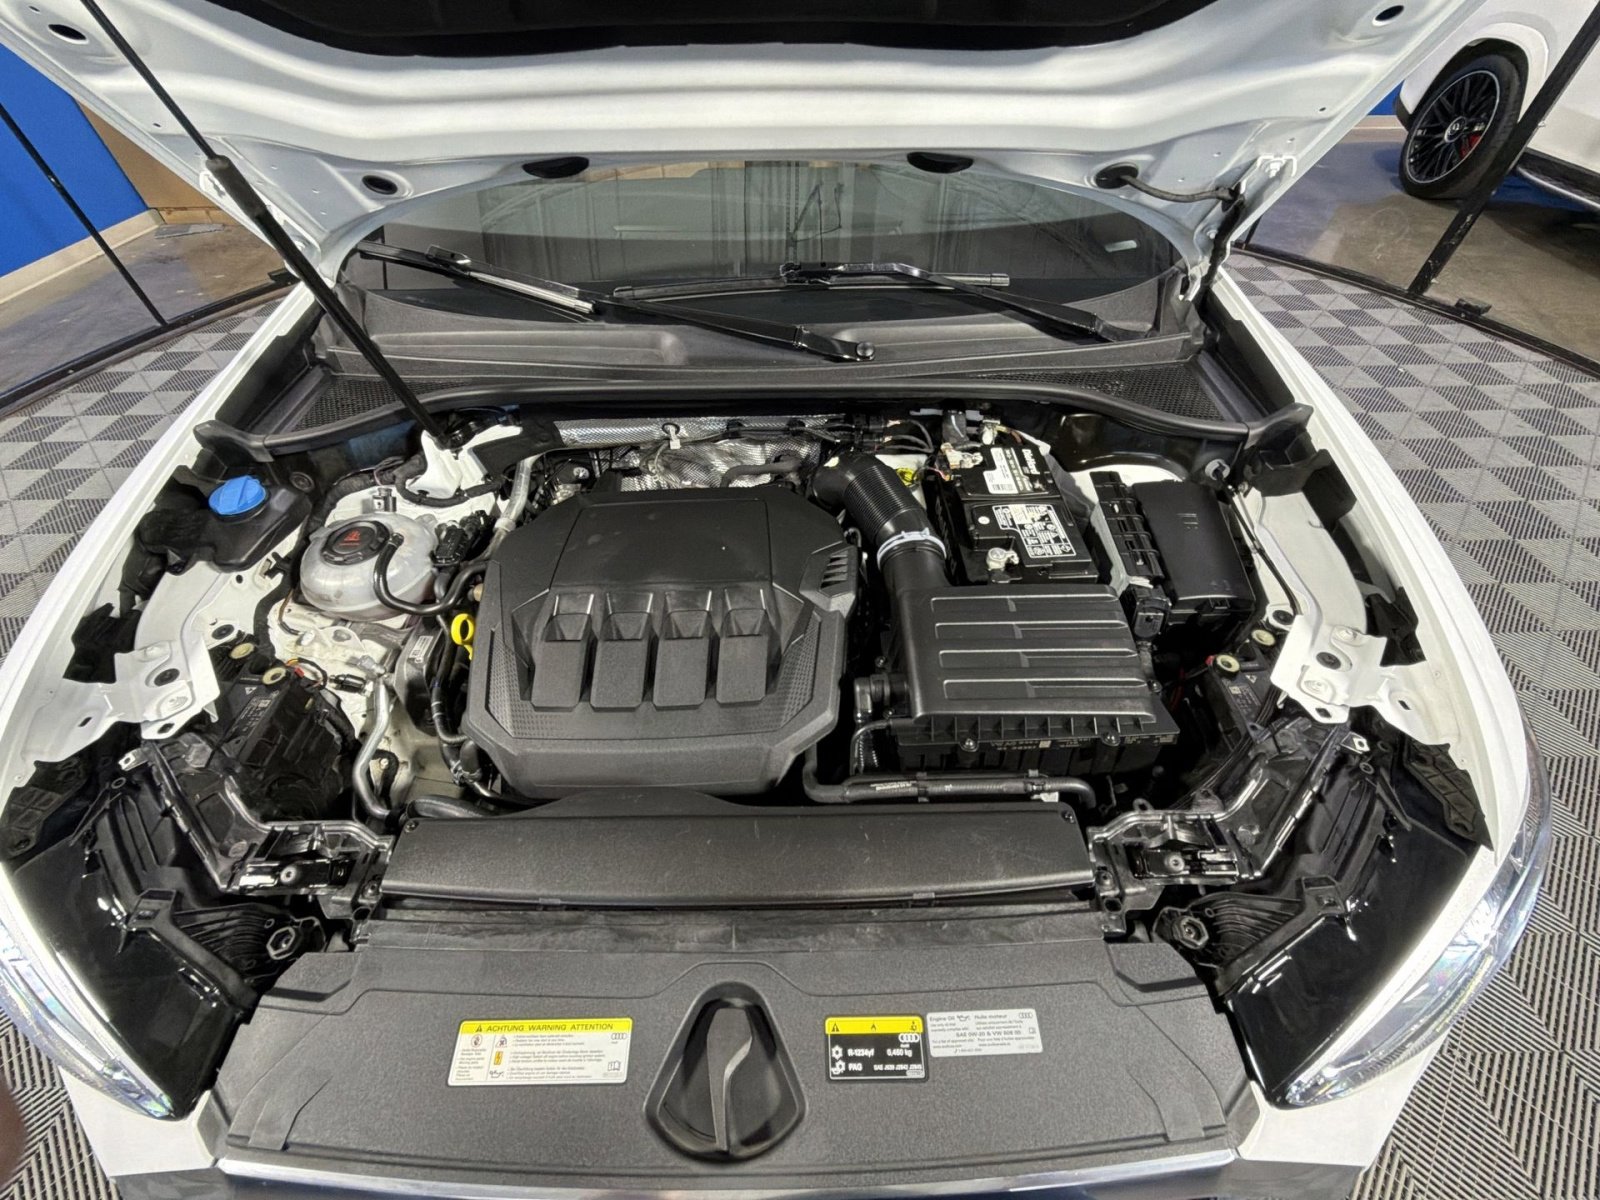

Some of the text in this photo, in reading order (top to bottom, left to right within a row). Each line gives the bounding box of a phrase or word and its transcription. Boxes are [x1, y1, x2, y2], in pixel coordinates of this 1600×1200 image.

[486, 1024, 524, 1032] ACHTUNG
[570, 1023, 614, 1031] ATTENTION
[847, 1047, 875, 1058] R-1234yf
[904, 1048, 913, 1058] kg
[848, 1062, 863, 1072] PAG
